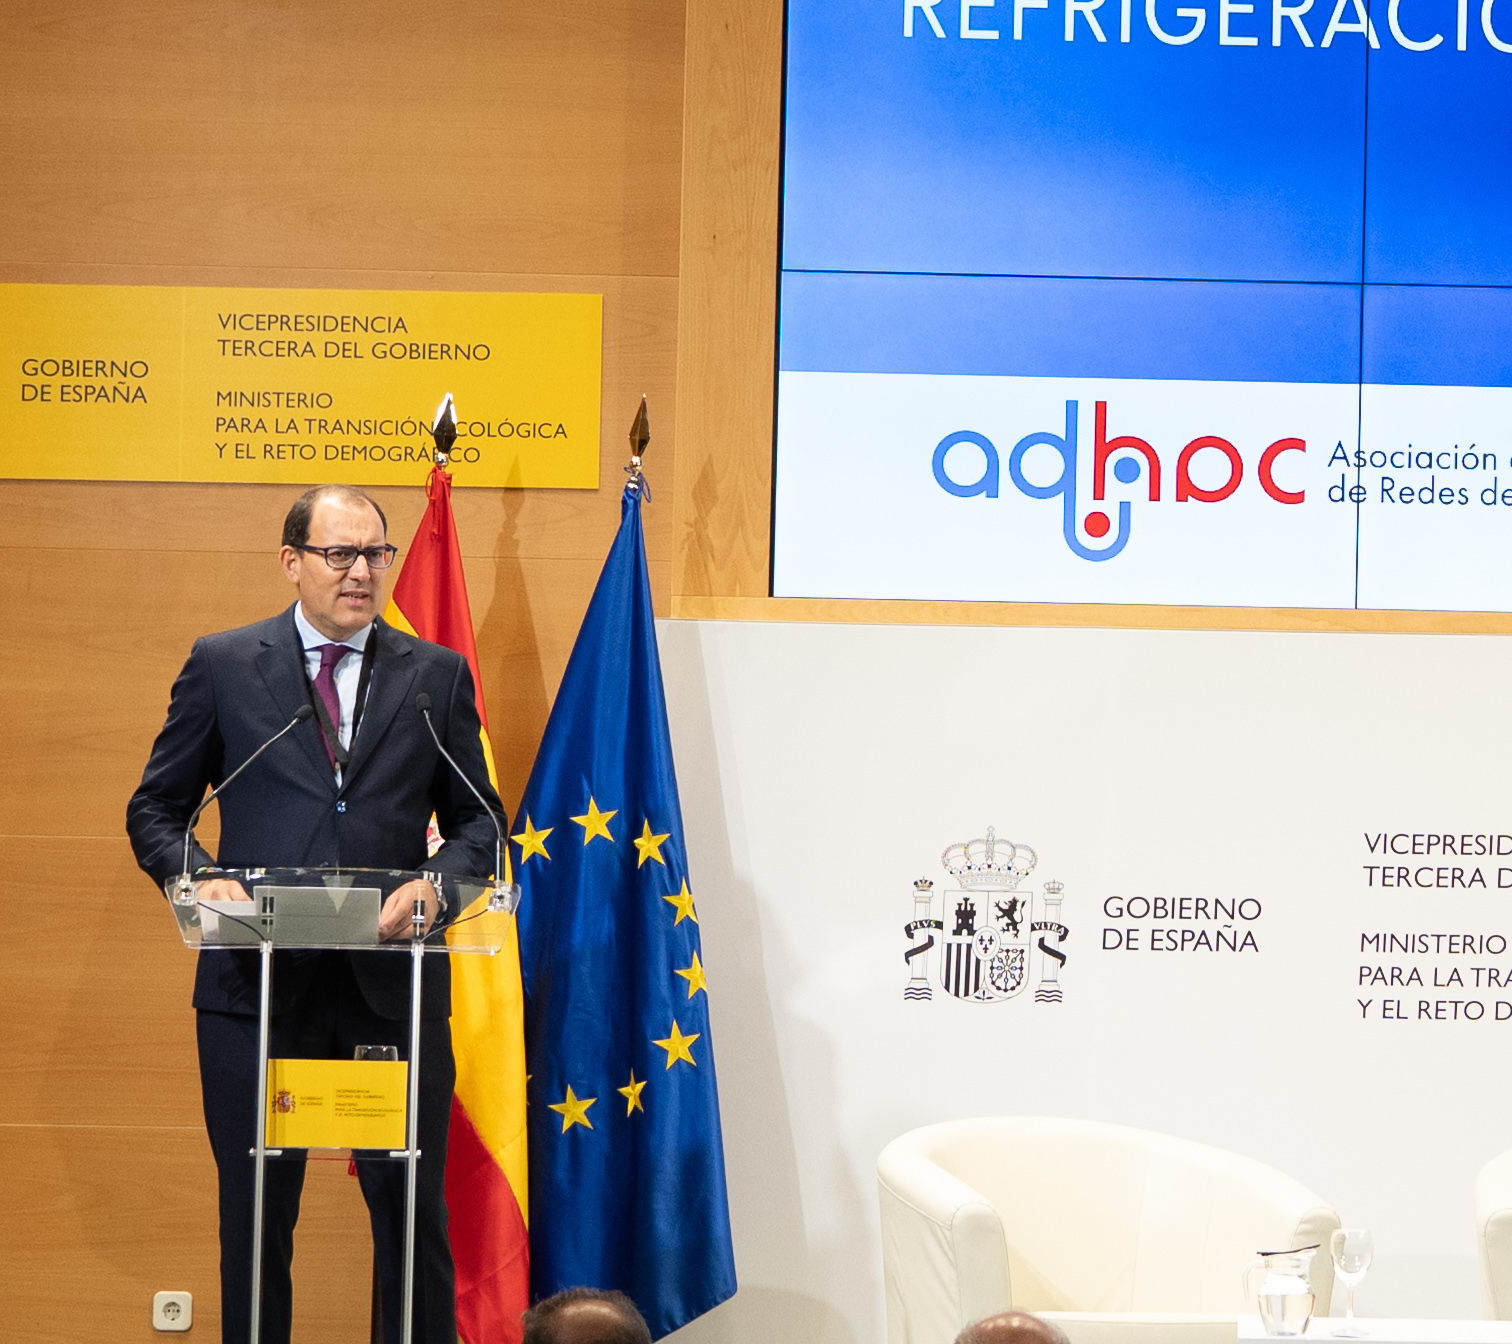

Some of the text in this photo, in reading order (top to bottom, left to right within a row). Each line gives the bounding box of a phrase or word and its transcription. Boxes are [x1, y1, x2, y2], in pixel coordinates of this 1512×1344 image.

[218, 314, 408, 333] VICEPRESIDENCIA
[217, 340, 490, 360] TERCERA DEL GOBIERNO
[22, 359, 148, 378] GOBIERNO
[22, 382, 147, 403] DE ESPAÑA
[217, 391, 332, 408] MINISTERIO
[216, 417, 567, 438] PARA LA TRANSICIÓN COLÓGICA
[215, 443, 227, 458] Y
[236, 444, 256, 459] EL
[264, 445, 316, 460] RETO
[1328, 440, 1497, 473] Asociación
[1329, 477, 1367, 503] de
[1381, 478, 1468, 507] Redes
[1363, 866, 1486, 888] TERCERA
[1104, 896, 1261, 920] GOBIERNO
[1103, 925, 1258, 952] DE ESPAÑA
[1361, 933, 1506, 954] MINISTERIO
[1359, 966, 1423, 986] PARA
[1434, 968, 1463, 987] LA
[1358, 999, 1372, 1018] Y
[1383, 1000, 1408, 1019] EL
[1418, 1001, 1484, 1020] RETO
